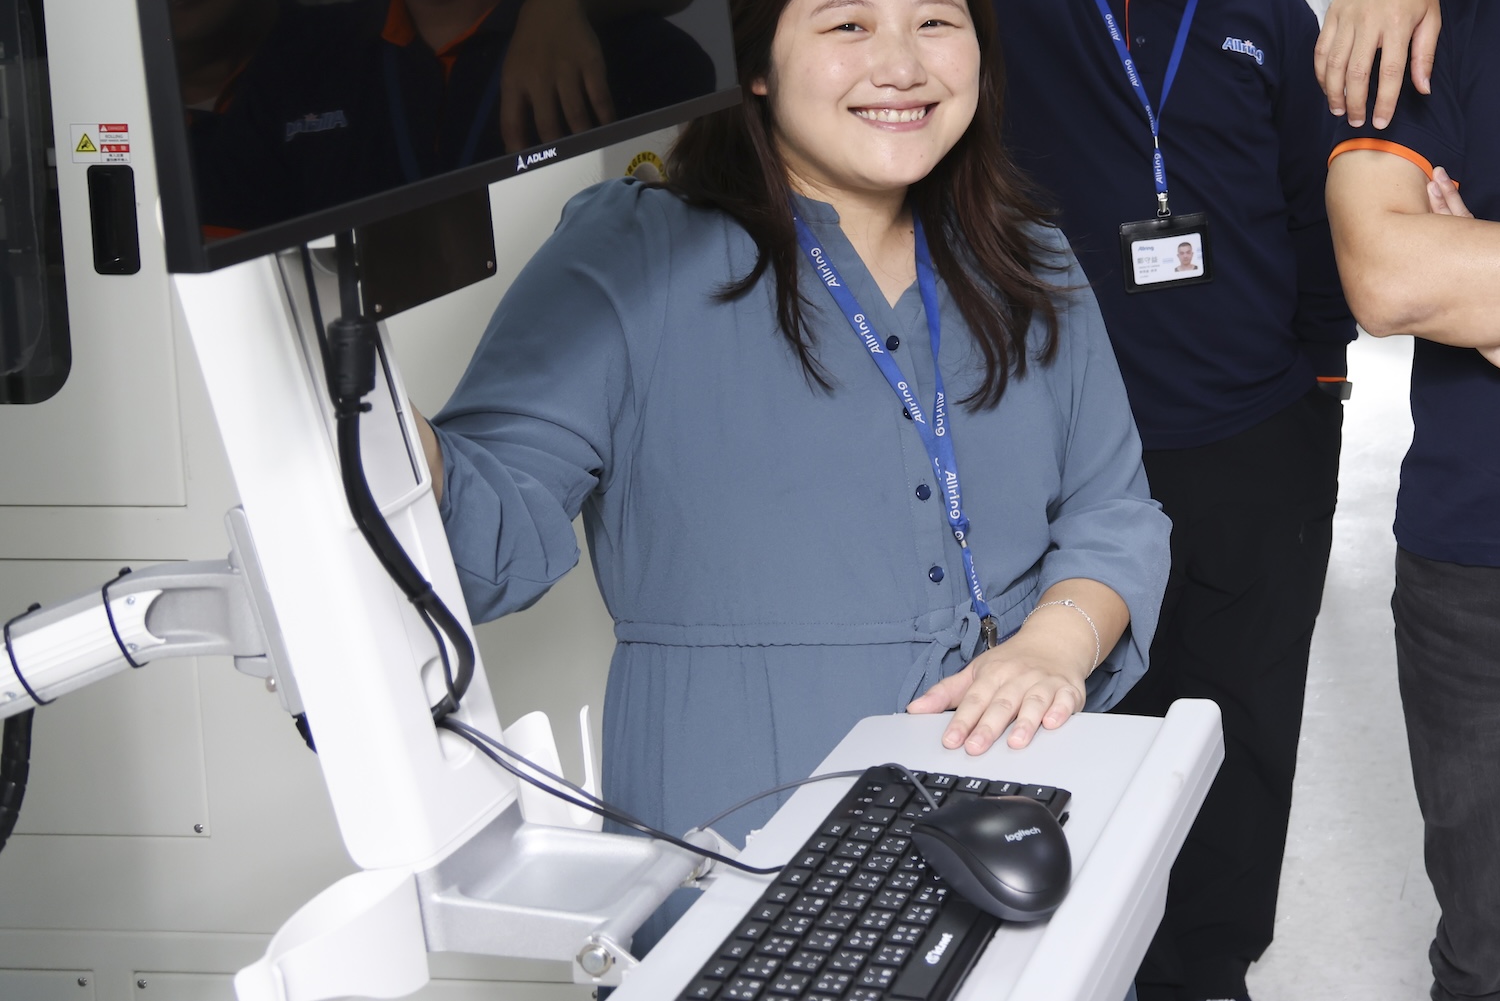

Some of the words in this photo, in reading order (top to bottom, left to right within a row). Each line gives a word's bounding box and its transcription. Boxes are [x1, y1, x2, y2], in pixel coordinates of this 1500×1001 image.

[1105, 13, 1121, 42] Allring
[1222, 37, 1264, 65] Allring
[1125, 59, 1139, 87] Allring
[527, 147, 557, 165] ADLINK
[1154, 153, 1164, 184] Allring
[810, 247, 841, 287] Allring
[853, 313, 884, 354] Allring
[897, 381, 926, 424] Allring
[935, 391, 945, 437] Allring
[945, 470, 961, 519] Allring
[1004, 826, 1041, 842] logitech
